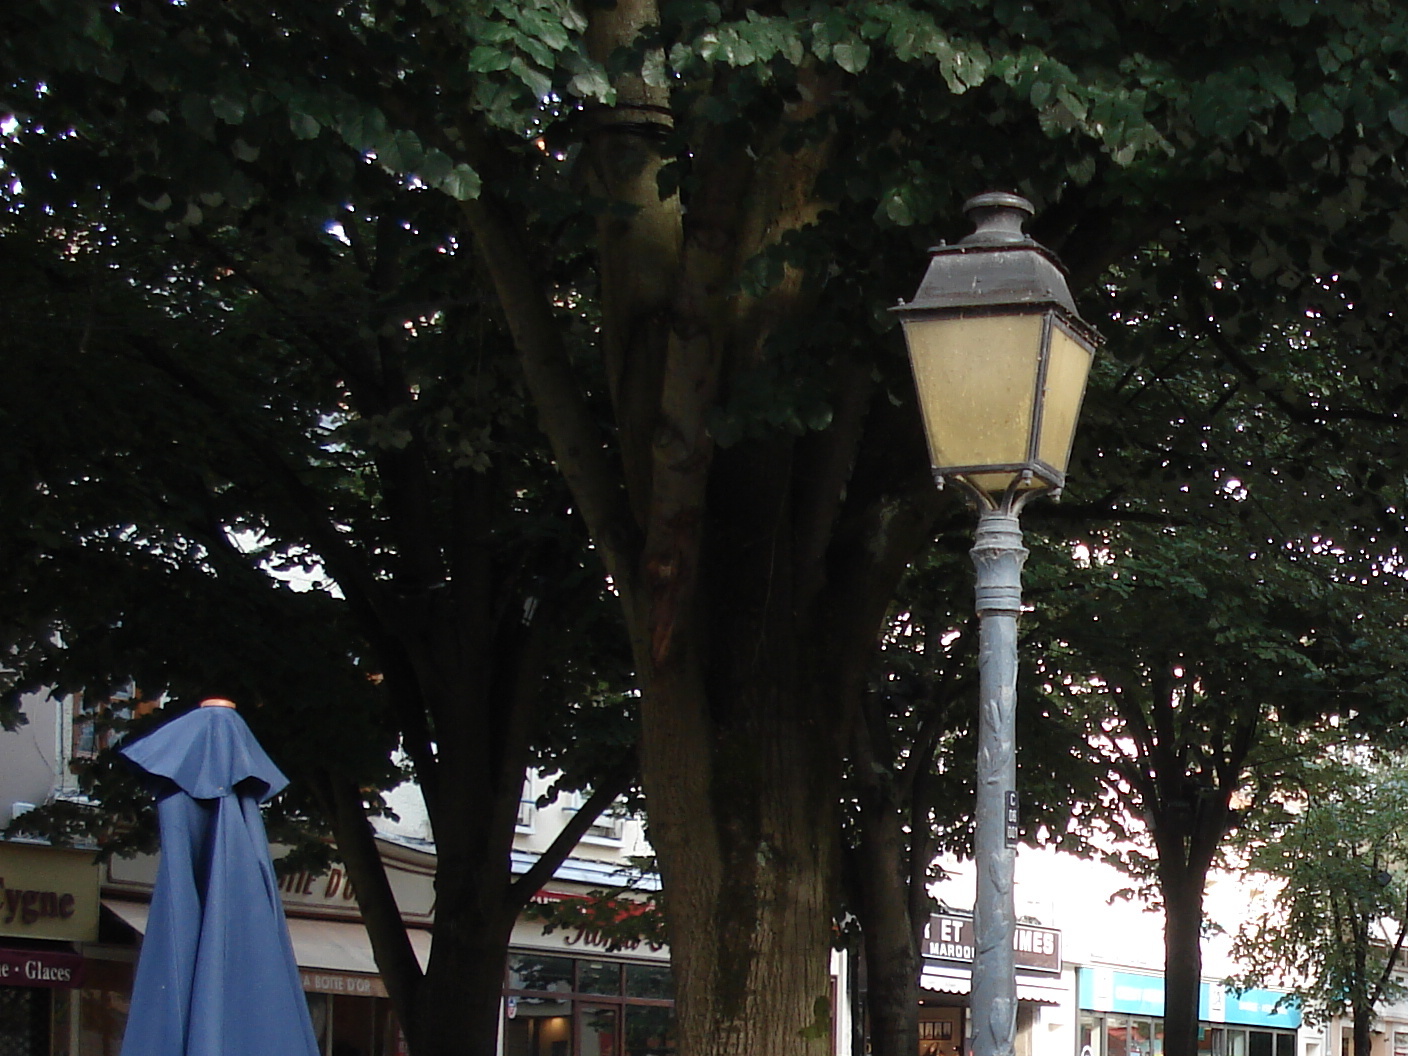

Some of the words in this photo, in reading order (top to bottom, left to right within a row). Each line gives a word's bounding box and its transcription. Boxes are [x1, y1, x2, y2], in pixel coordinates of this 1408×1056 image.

[941, 919, 963, 943] ET
[25, 960, 71, 982] Glaces
[315, 975, 343, 990] BOTTE
